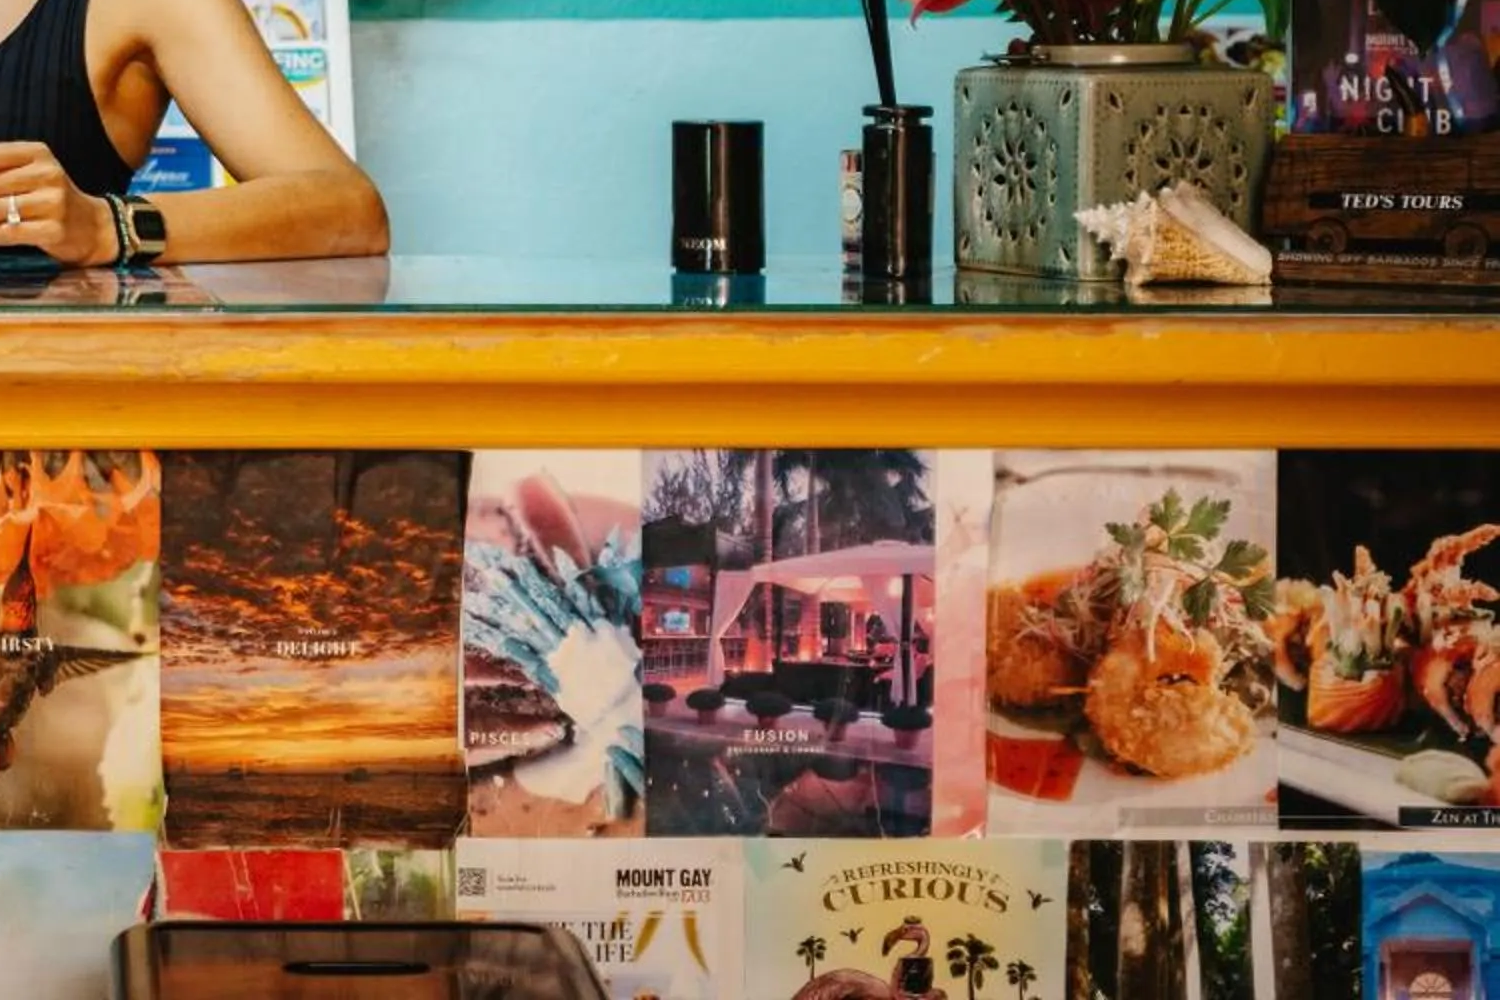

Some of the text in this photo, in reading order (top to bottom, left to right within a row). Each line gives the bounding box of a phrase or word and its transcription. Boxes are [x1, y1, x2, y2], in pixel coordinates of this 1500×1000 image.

[1340, 76, 1435, 102] NIGT
[1377, 108, 1452, 135] CLB
[1341, 193, 1464, 210] TED'S TOURS
[275, 640, 358, 656] DELIGHT
[469, 731, 531, 746] PISCES
[743, 729, 810, 742] FUSION
[1430, 809, 1460, 825] ZEN
[1462, 814, 1478, 825] AT
[615, 868, 713, 887] MOUNT GAY
[842, 860, 989, 883] REFRESHINGLY
[822, 875, 1010, 914] CURIOUS
[582, 920, 634, 941] THE
[590, 942, 634, 963] IFE
